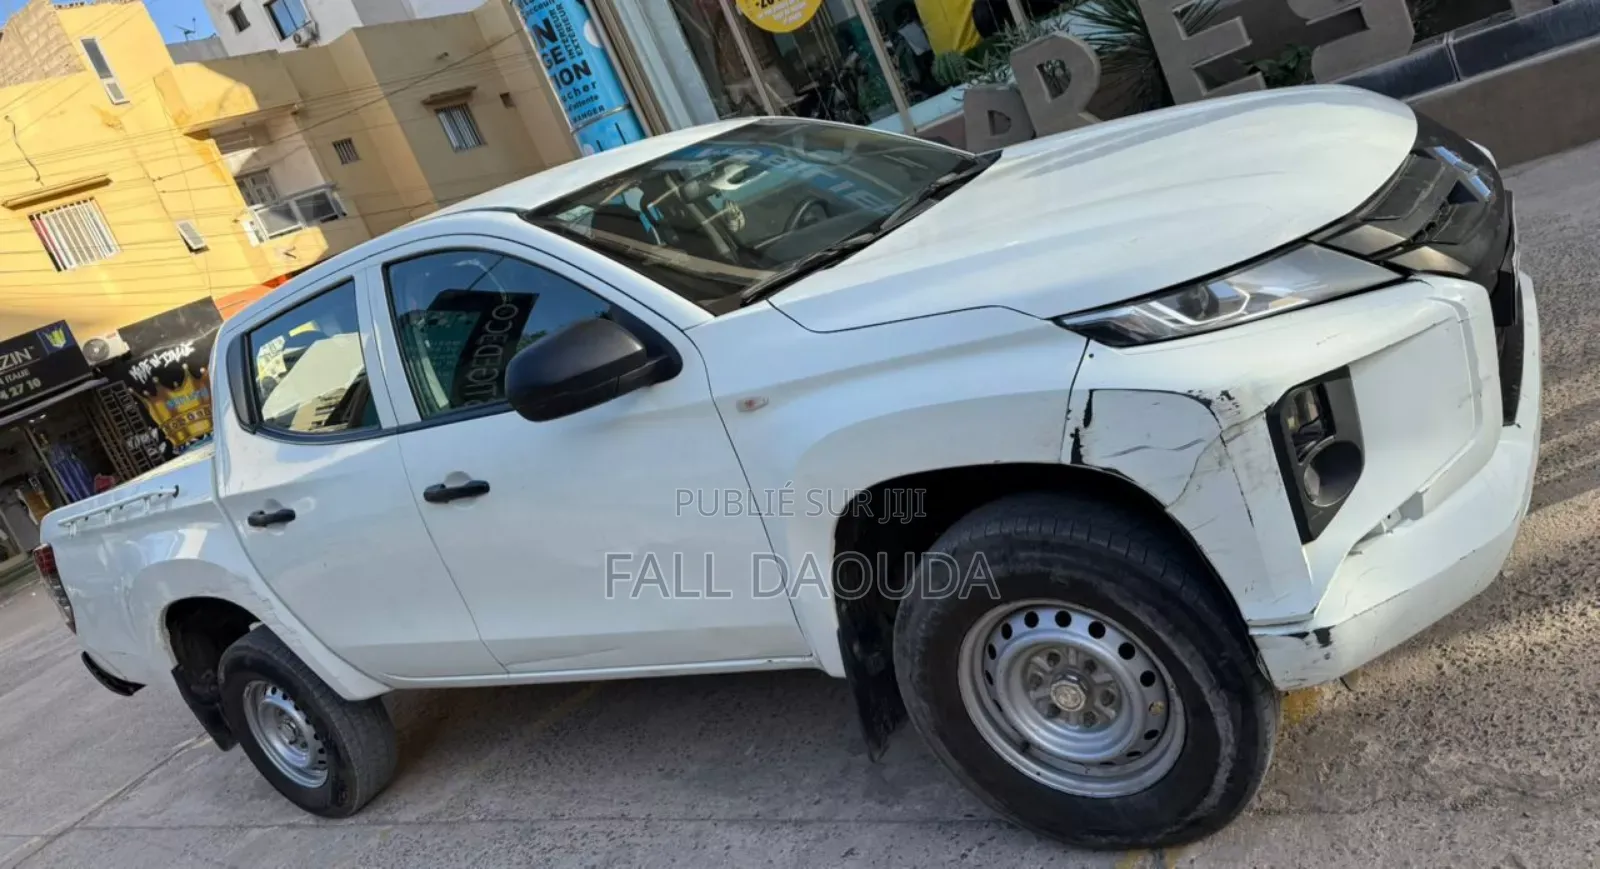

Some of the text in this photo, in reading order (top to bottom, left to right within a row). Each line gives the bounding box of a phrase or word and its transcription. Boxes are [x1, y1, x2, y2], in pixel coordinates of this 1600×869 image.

[550, 8, 576, 59] INTERIEUR
[556, 3, 583, 57] EXTERIEUR
[9, 383, 24, 398] 27
